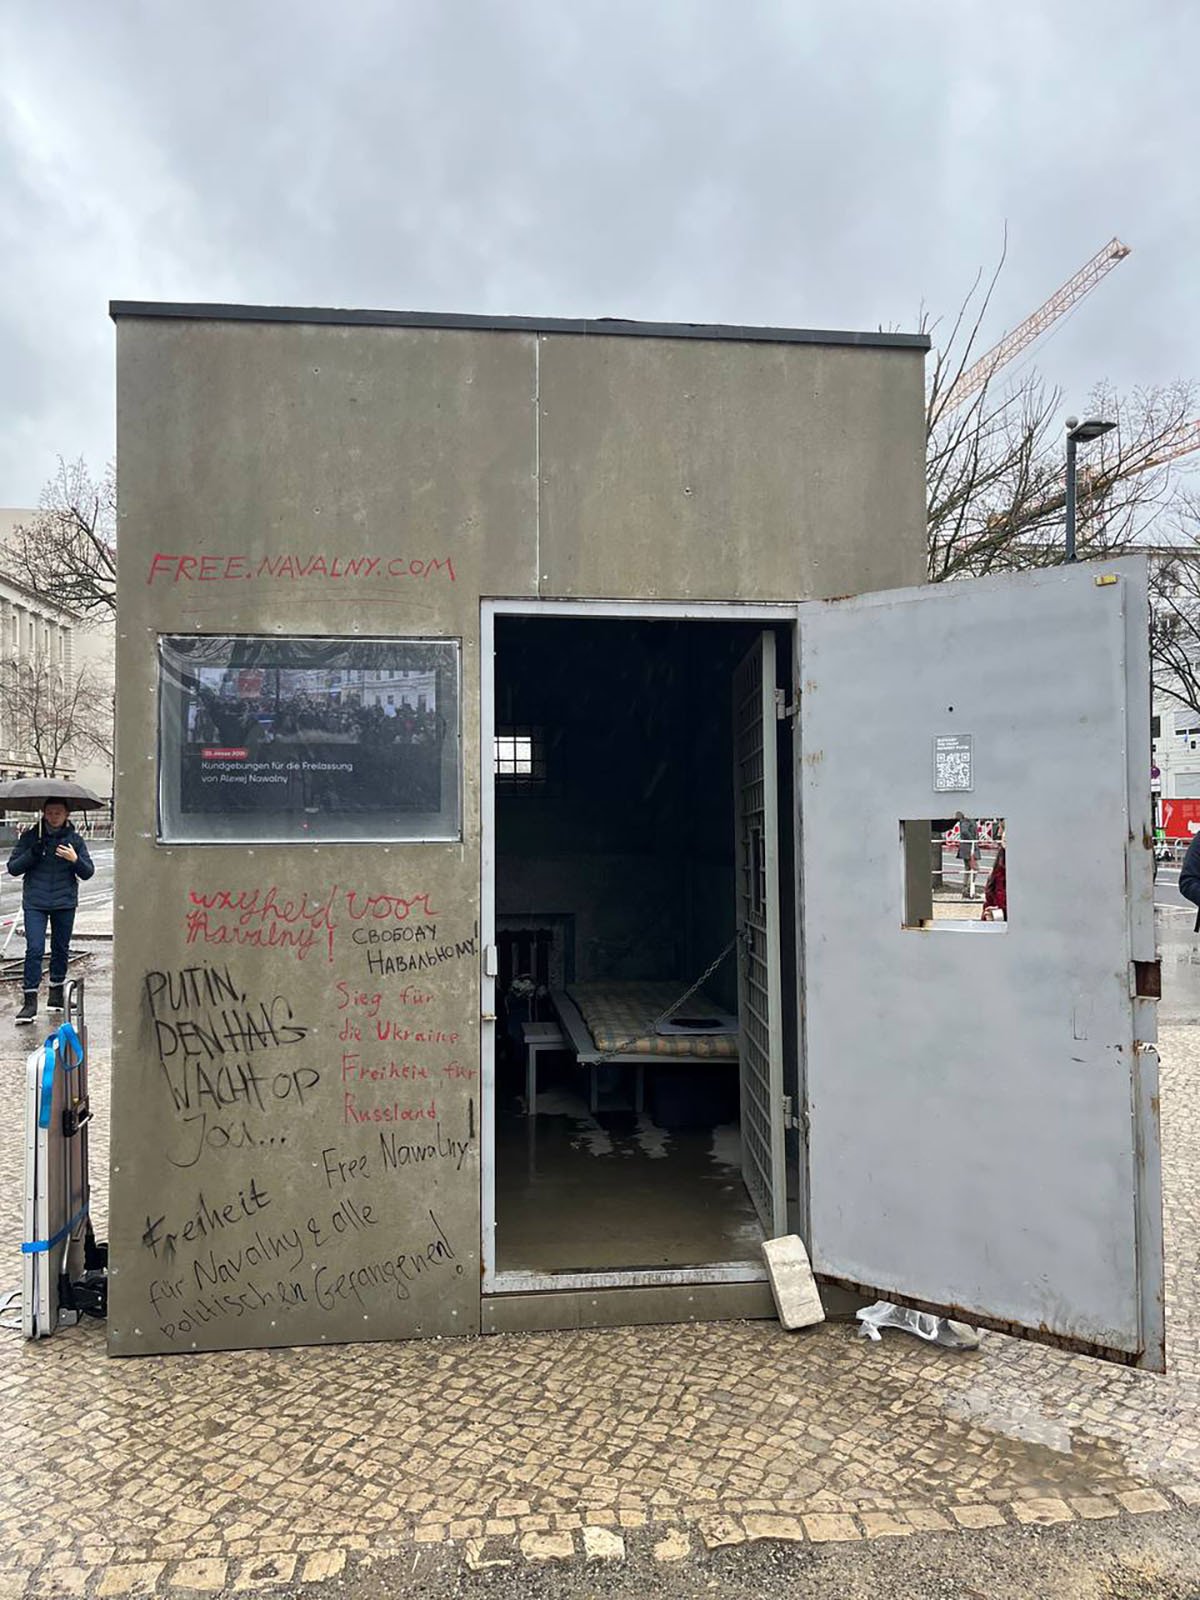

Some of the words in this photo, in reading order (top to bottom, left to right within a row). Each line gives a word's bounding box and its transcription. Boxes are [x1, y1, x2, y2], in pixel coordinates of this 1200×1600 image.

[147, 553, 455, 585] FREE.NAVALNY.COM
[201, 761, 270, 772] Kundgebungen
[271, 761, 284, 770] für
[286, 761, 300, 770] die
[302, 761, 354, 772] Freilassung
[219, 774, 247, 785] Alexej
[249, 774, 289, 784] Nawalny
[336, 981, 383, 1018] Sieg
[400, 985, 434, 1005] für
[338, 1017, 362, 1041] die
[376, 1019, 460, 1044] Ukraine
[341, 1053, 429, 1082] Freiheit
[442, 1060, 478, 1081] für
[272, 1068, 320, 1106] OP
[343, 1091, 437, 1125] Russland
[322, 1147, 371, 1189] Free
[142, 1178, 272, 1258] Freiheit
[150, 1278, 184, 1318] für
[193, 1230, 305, 1291] Navalny
[332, 1199, 379, 1232] alle
[159, 1281, 308, 1341] politischen
